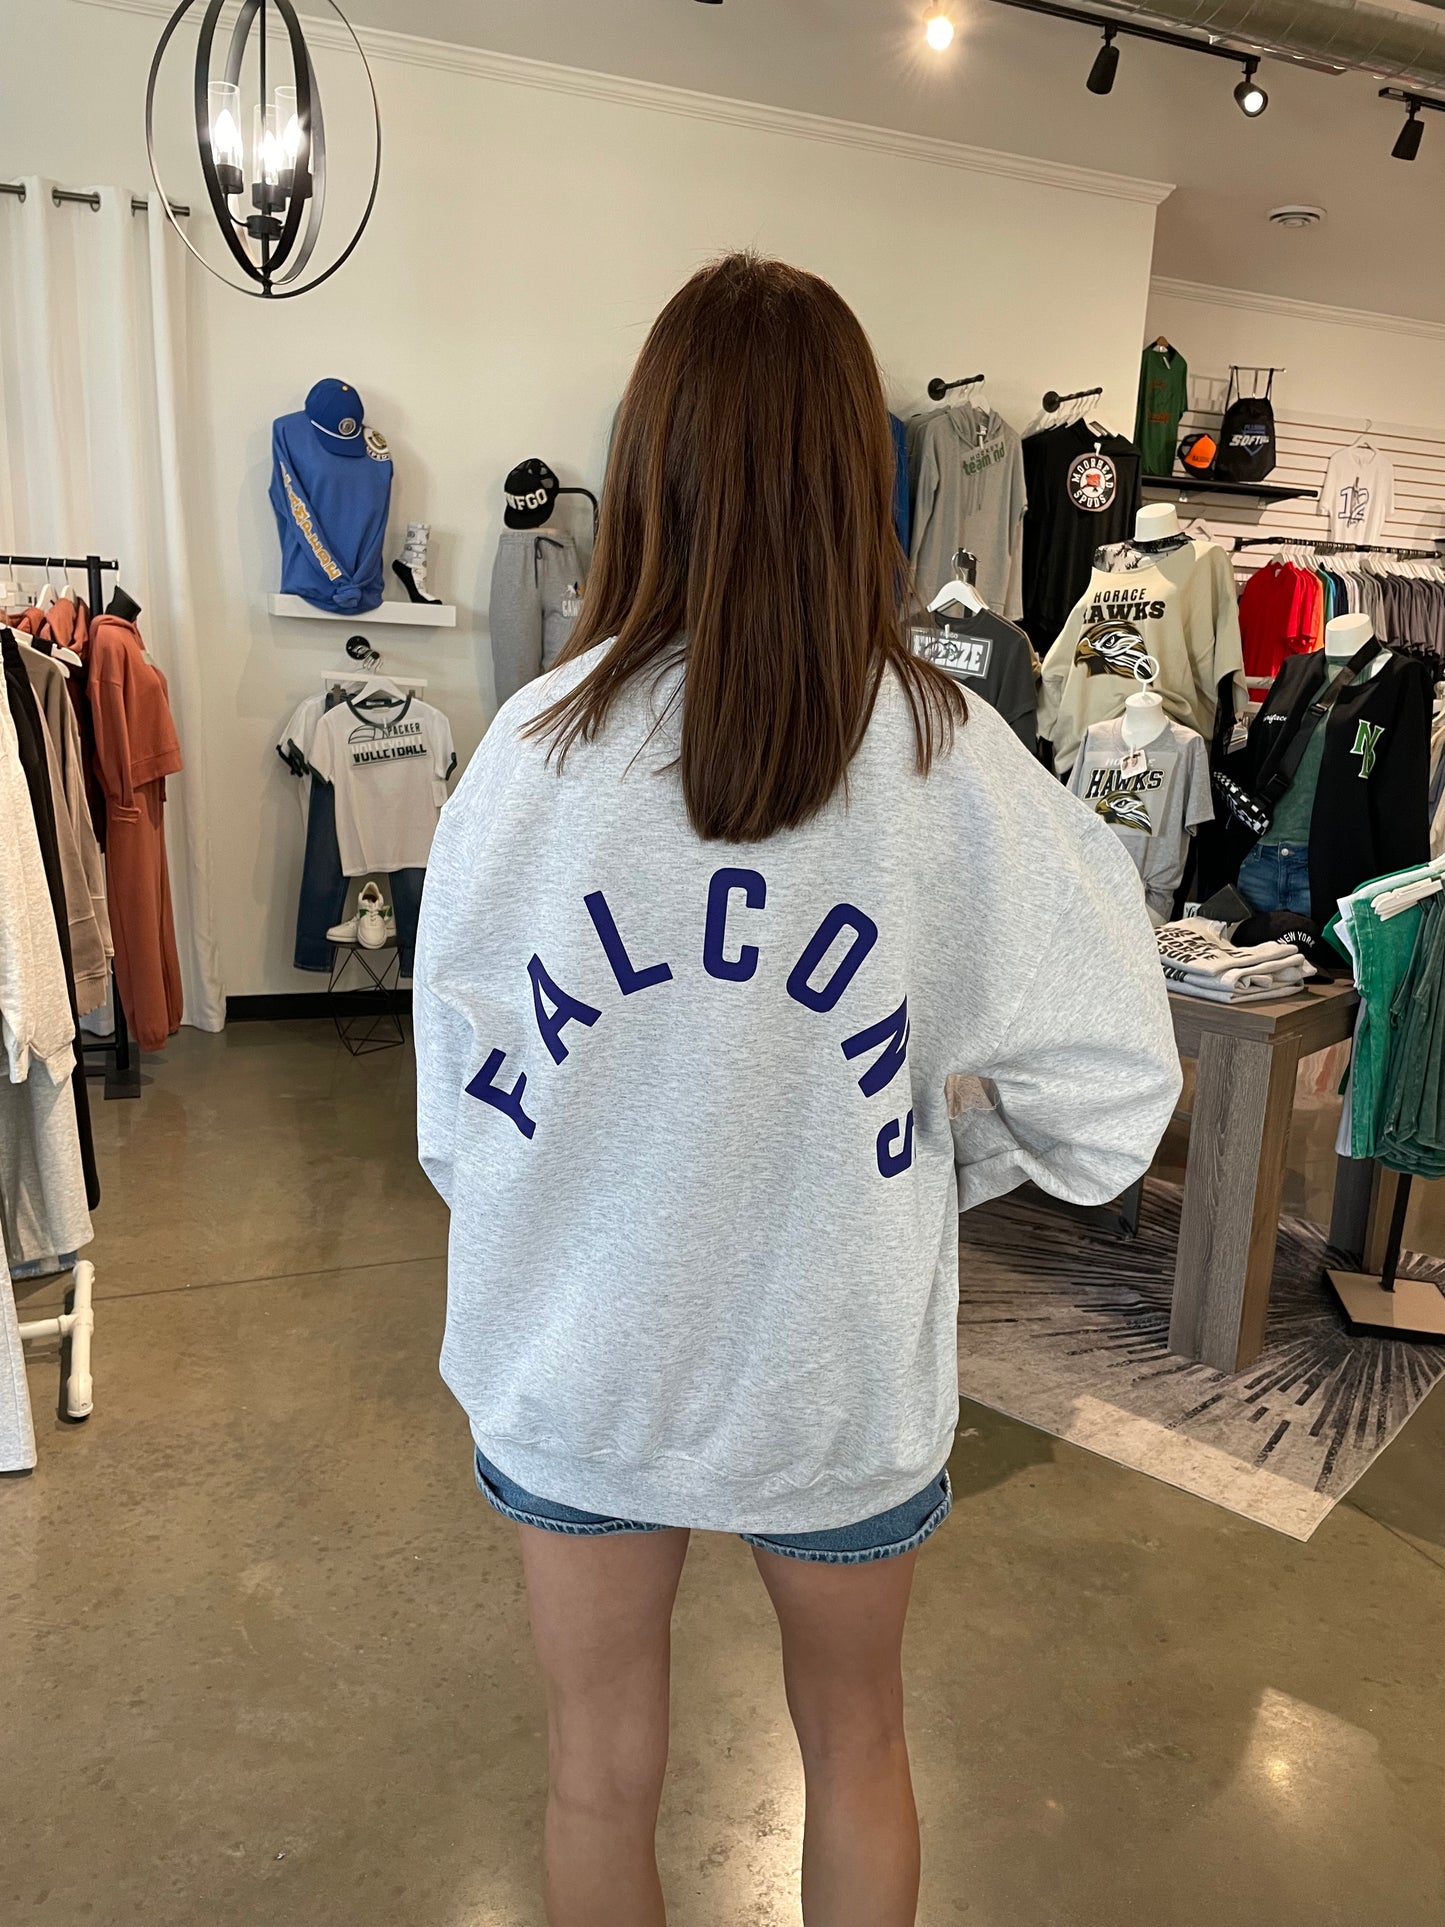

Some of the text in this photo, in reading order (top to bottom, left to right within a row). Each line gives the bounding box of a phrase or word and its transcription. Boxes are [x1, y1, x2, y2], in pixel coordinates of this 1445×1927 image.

[962, 441, 1005, 476] team nd
[1071, 458, 1114, 489] MOORHEAD
[1073, 489, 1107, 508] SPUDS
[1338, 485, 1370, 522] 12
[1093, 588, 1147, 604] HORACE
[1083, 600, 1166, 625] AWKS
[387, 722, 421, 736] PACKER
[1083, 767, 1166, 800] HAWKS
[1277, 931, 1316, 948] NEW YORK
[465, 867, 915, 1178] FALCONS
